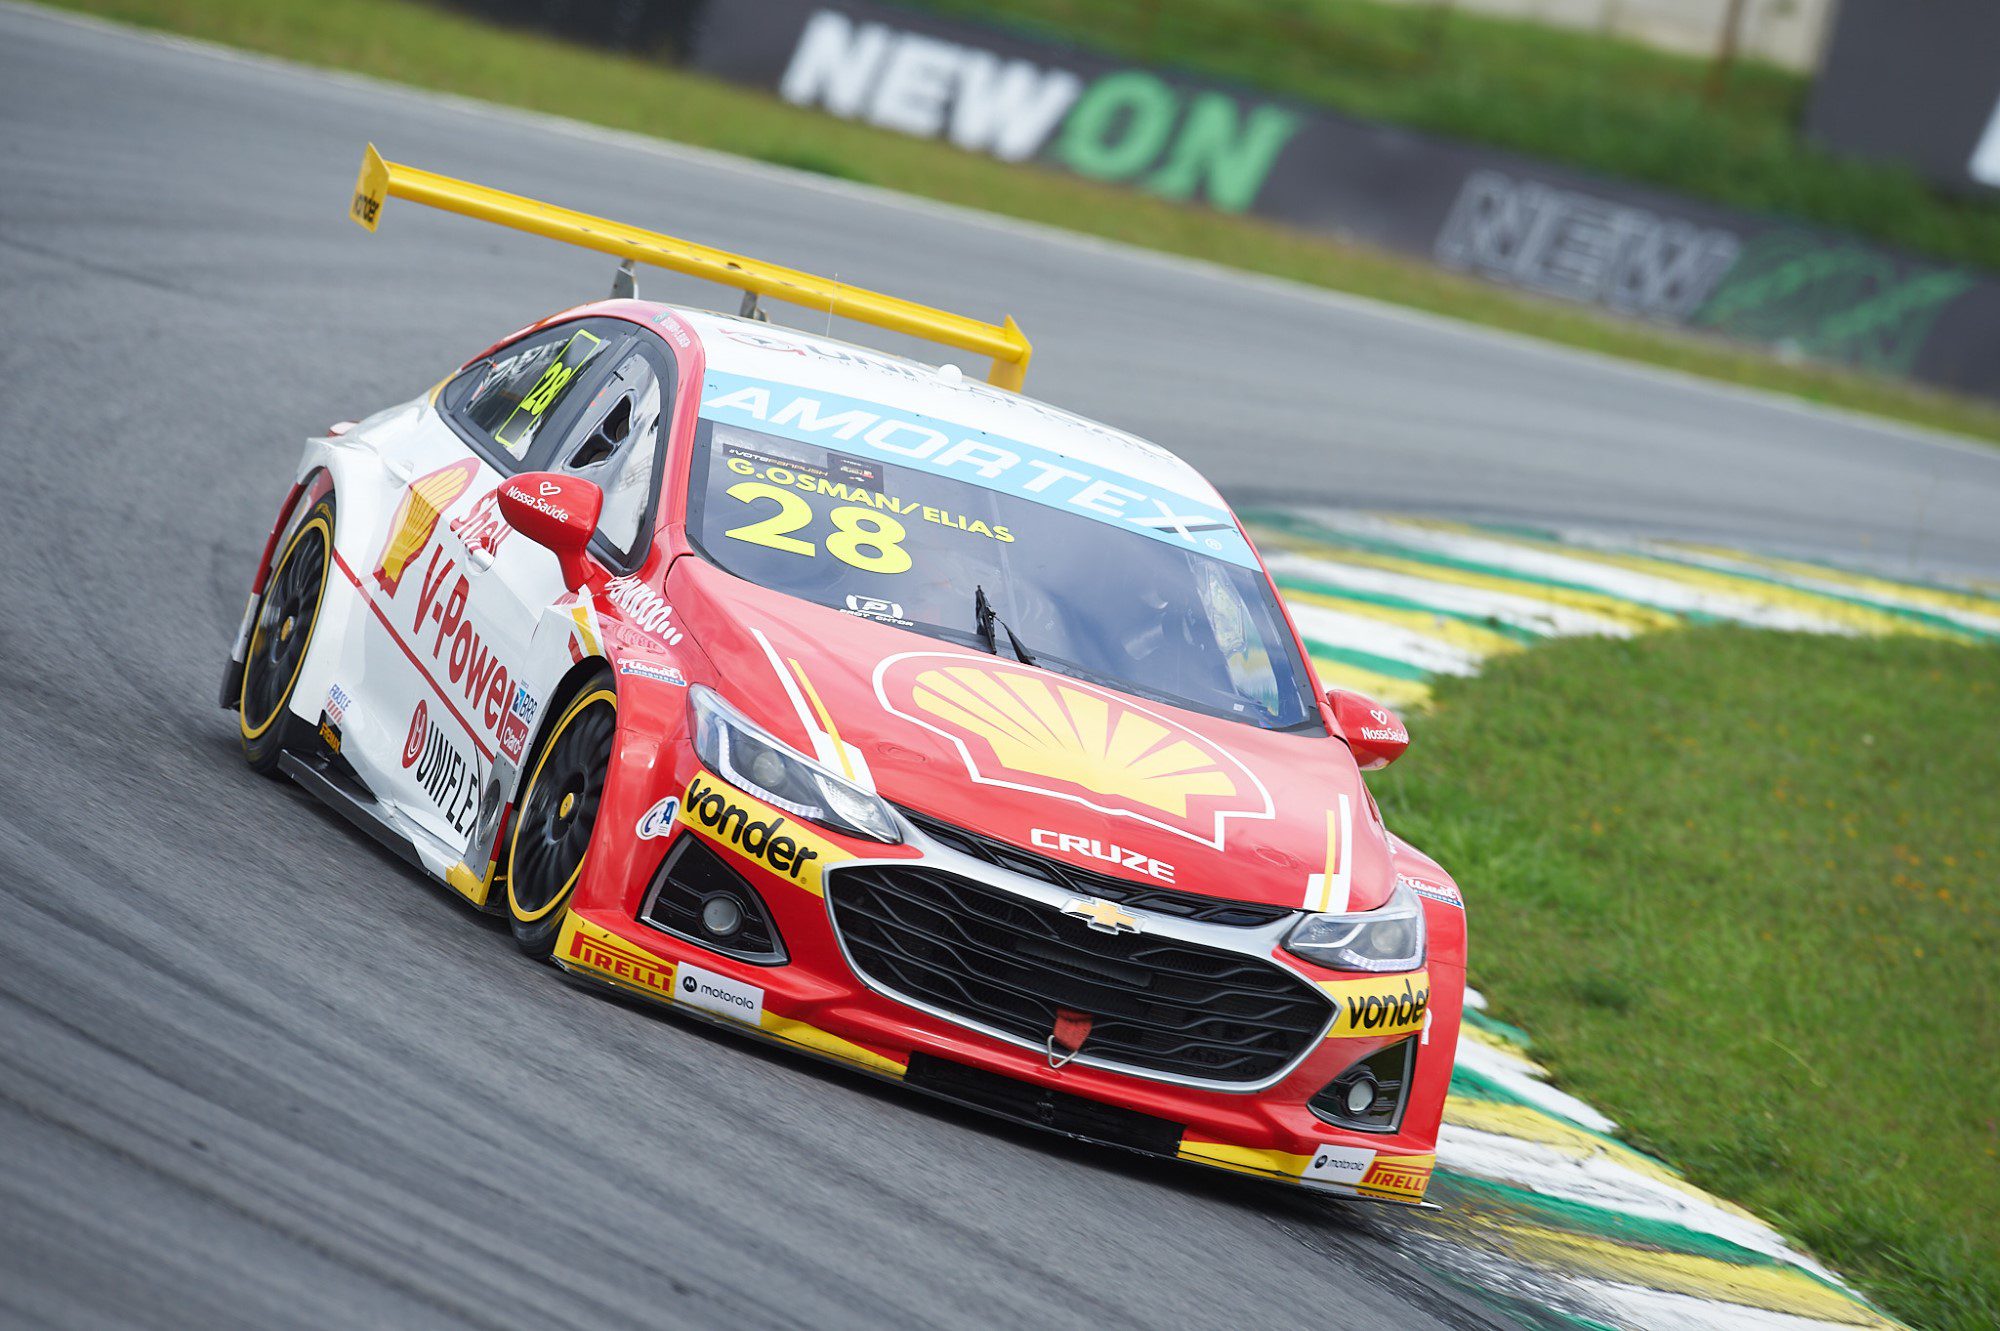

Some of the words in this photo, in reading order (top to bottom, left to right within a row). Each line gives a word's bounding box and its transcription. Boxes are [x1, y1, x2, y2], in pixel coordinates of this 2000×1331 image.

[520, 362, 572, 415] 28
[703, 387, 1222, 545] AMORTEX
[725, 482, 913, 574] 28
[519, 694, 537, 724] BRB
[686, 778, 818, 879] vonder
[1030, 828, 1176, 884] CRUZE
[570, 931, 673, 992] PIRELLI
[701, 982, 754, 1010] motorola
[1327, 1158, 1365, 1171] motorola
[1362, 1161, 1432, 1192] PIRELLI
